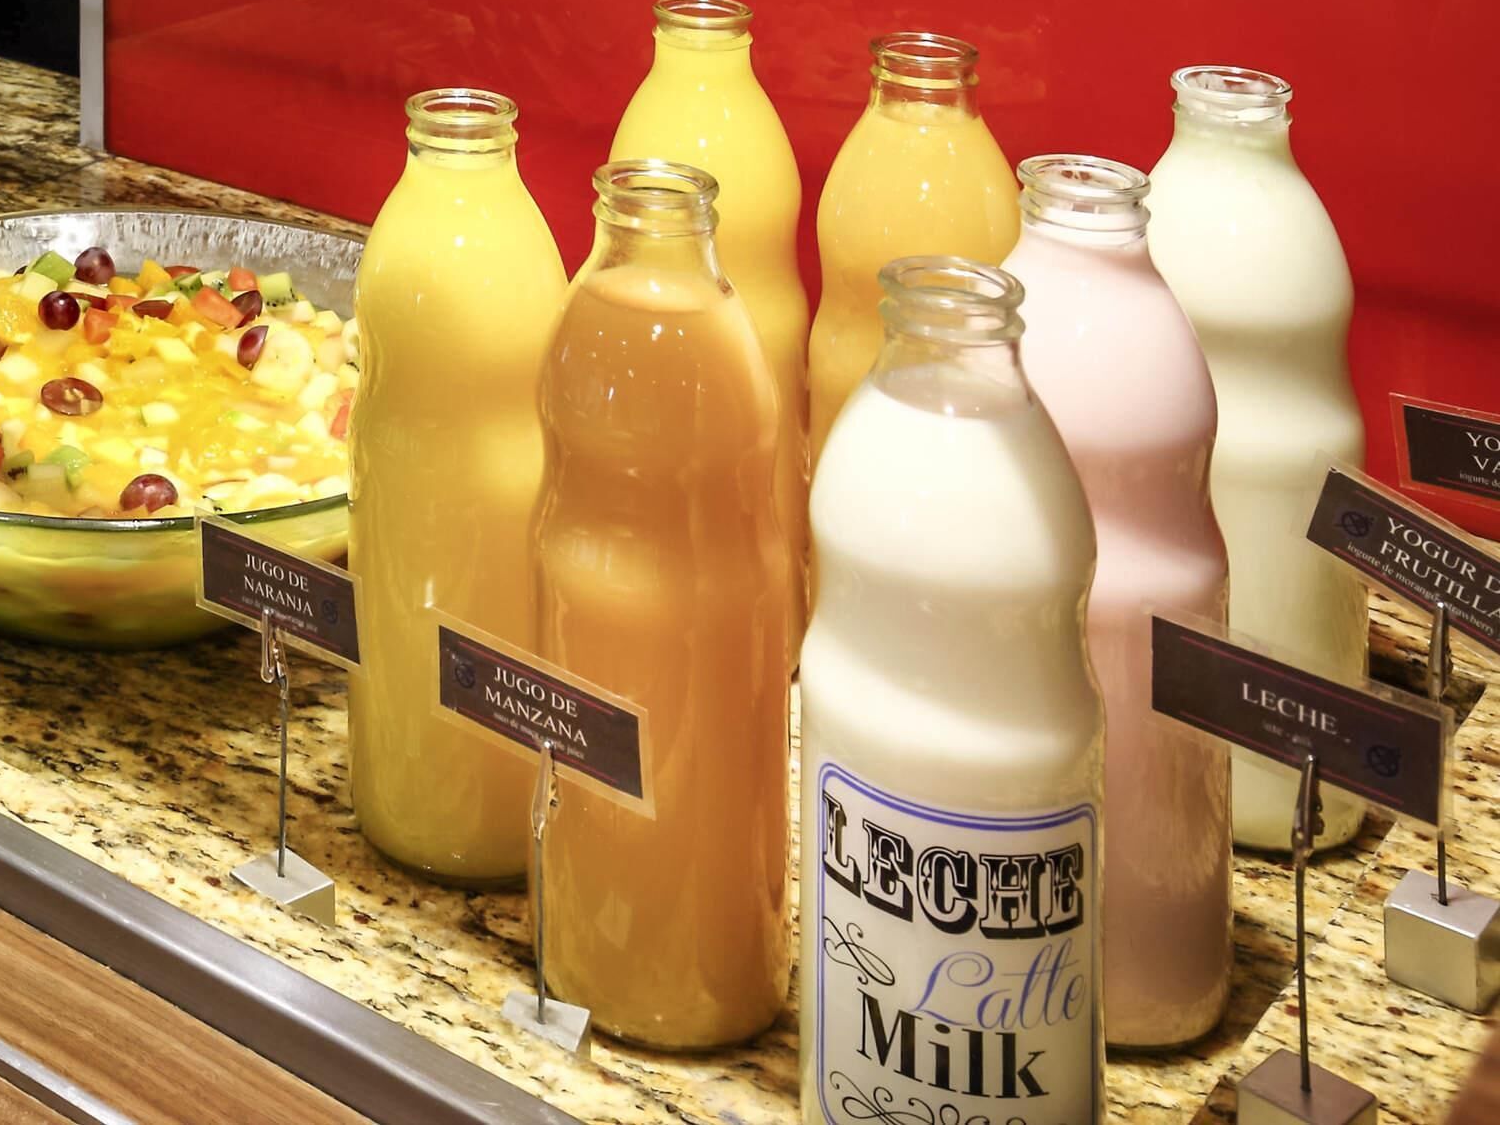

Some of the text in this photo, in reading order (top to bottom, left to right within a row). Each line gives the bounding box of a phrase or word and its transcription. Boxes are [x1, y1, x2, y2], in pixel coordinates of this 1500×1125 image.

[245, 553, 309, 592] JUGO DE
[1347, 541, 1381, 566] iogurte
[1382, 564, 1394, 575] de
[1388, 516, 1477, 581] YOGUR
[244, 575, 313, 616] NARANJA
[1380, 541, 1500, 619] FRUTILLA
[485, 685, 588, 747] MANZANA
[494, 666, 578, 718] JUGO DE
[1242, 682, 1338, 735] LECHE
[823, 789, 1085, 940] LECHE
[909, 937, 1086, 1031] Latte
[856, 987, 1050, 1099] Milk
